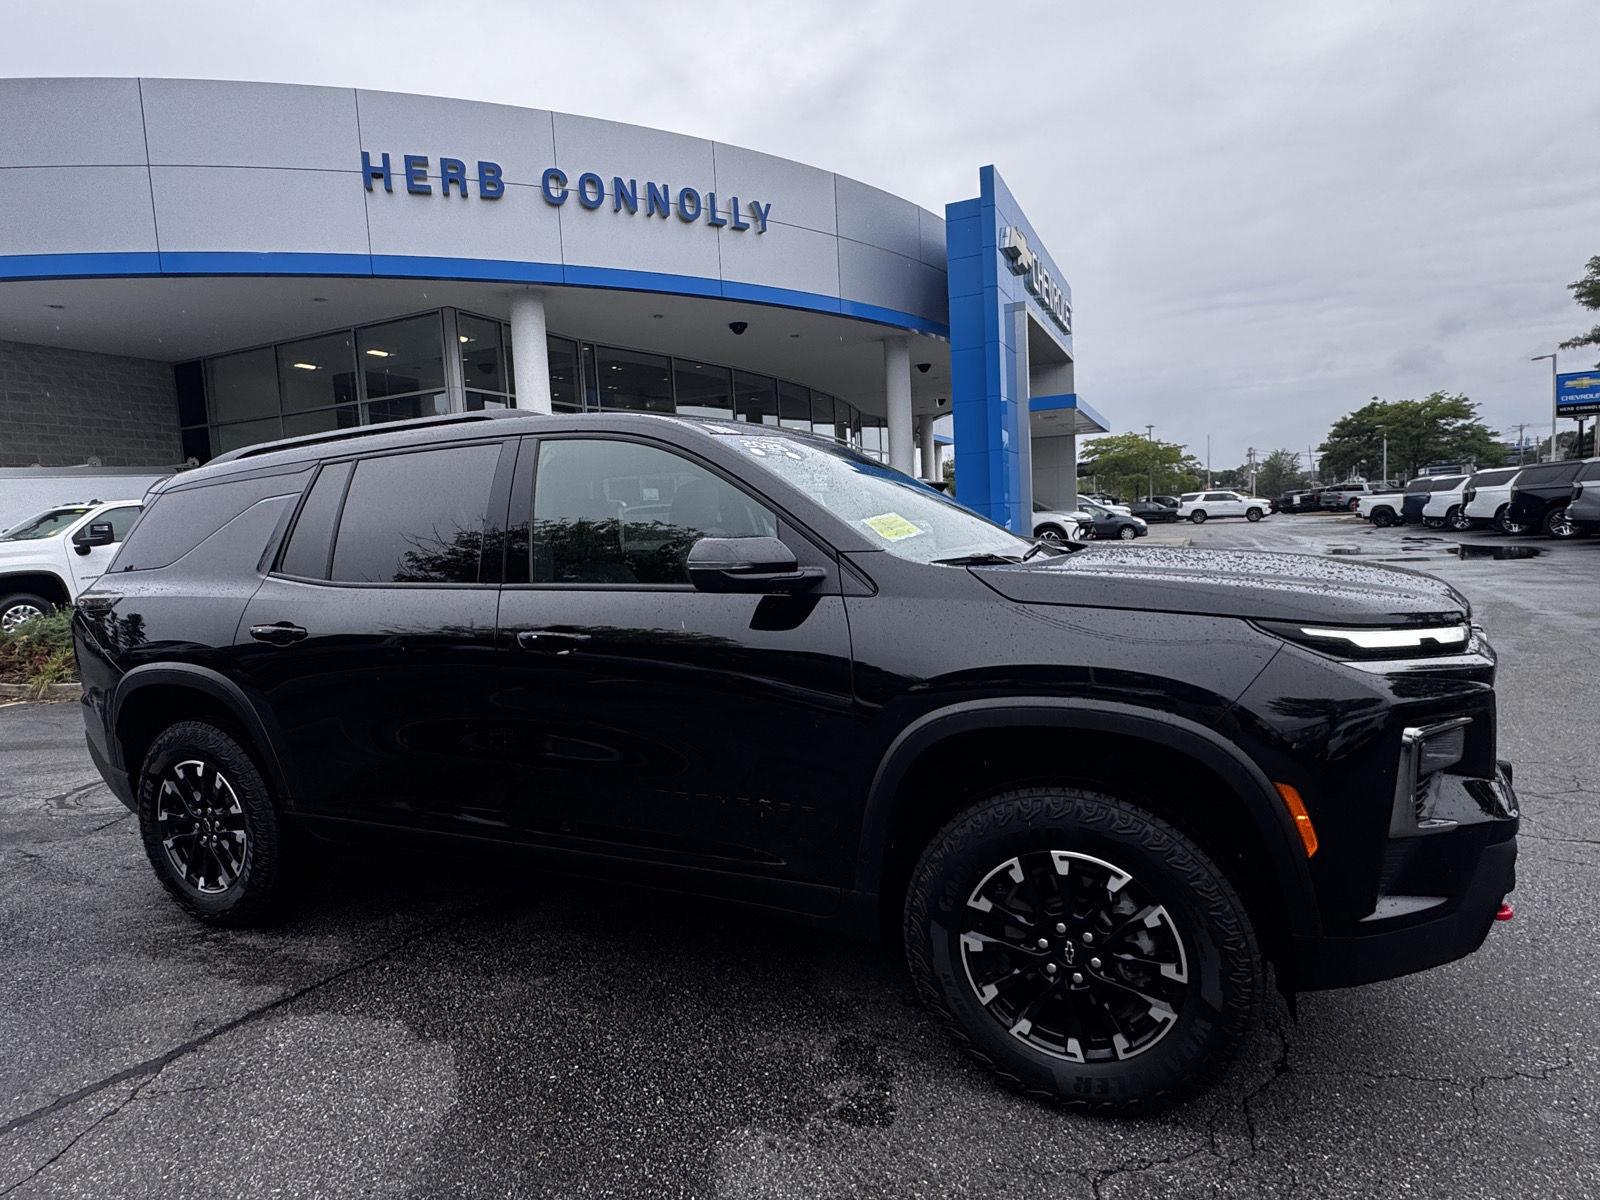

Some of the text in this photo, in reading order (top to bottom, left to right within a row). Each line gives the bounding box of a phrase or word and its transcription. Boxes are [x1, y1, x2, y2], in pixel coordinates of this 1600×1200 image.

[361, 150, 771, 235] HERB CONNOLLY
[1028, 251, 1072, 334] CHEVROLE
[1561, 393, 1600, 402] CHEVROLE
